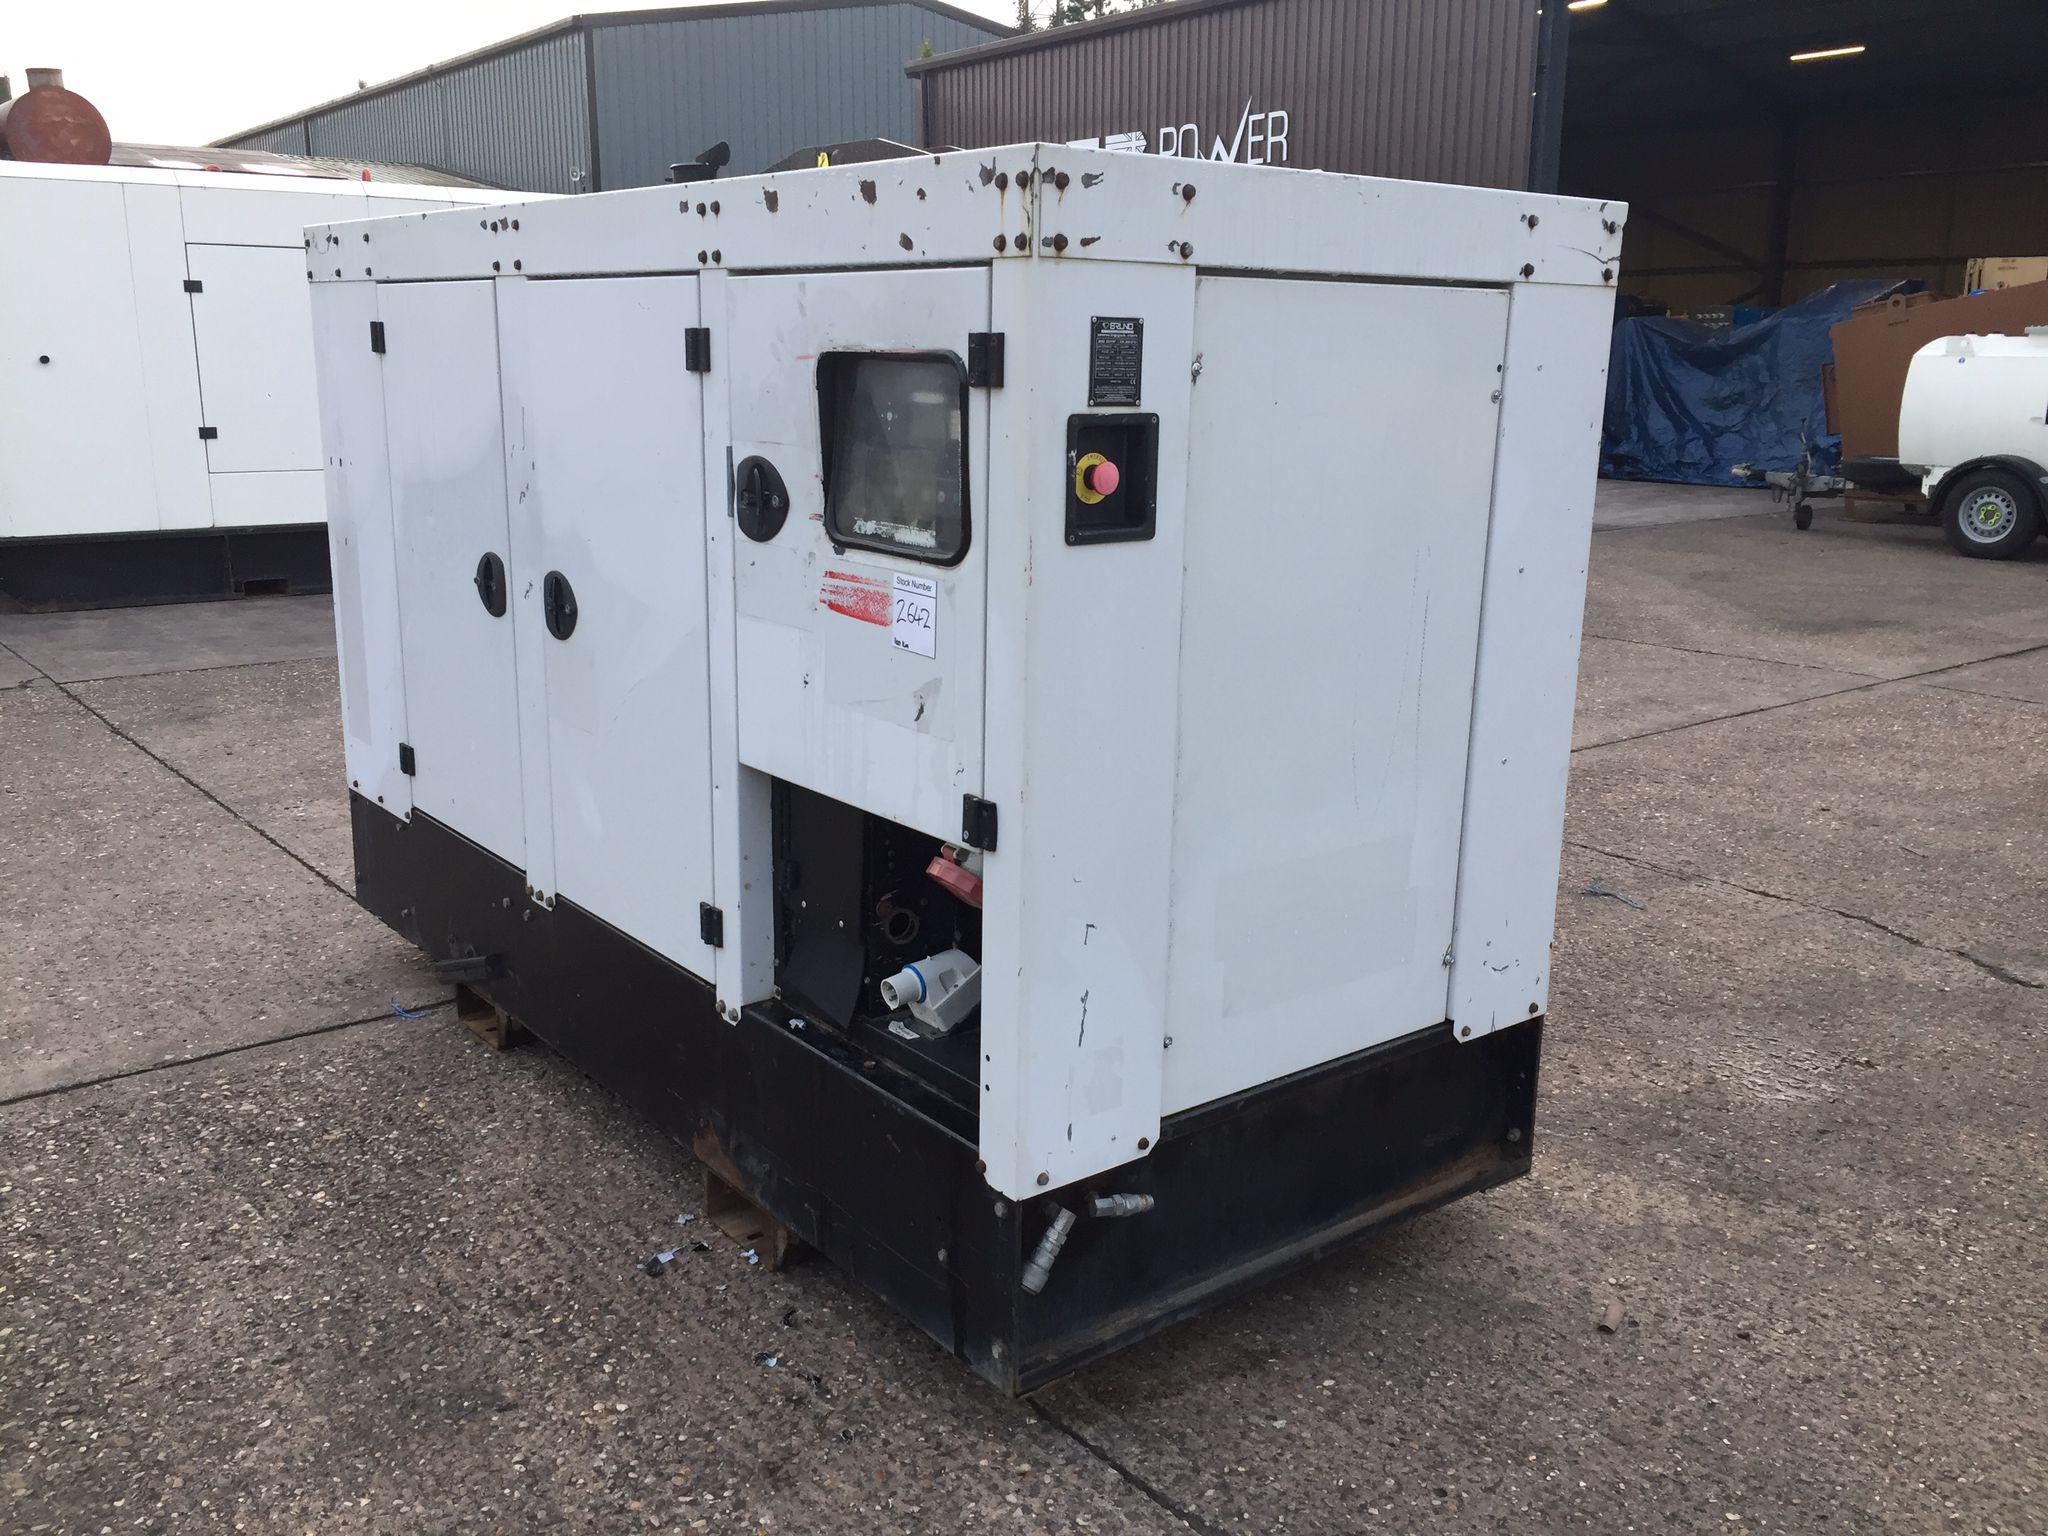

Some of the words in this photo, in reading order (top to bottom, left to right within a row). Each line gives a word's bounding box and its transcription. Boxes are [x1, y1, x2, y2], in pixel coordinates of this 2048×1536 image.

[1159, 96, 1289, 165] POWER
[1109, 322, 1134, 331] BRUNO
[896, 576, 911, 586] Stock
[911, 581, 933, 592] Number
[896, 599, 931, 629] 2642
